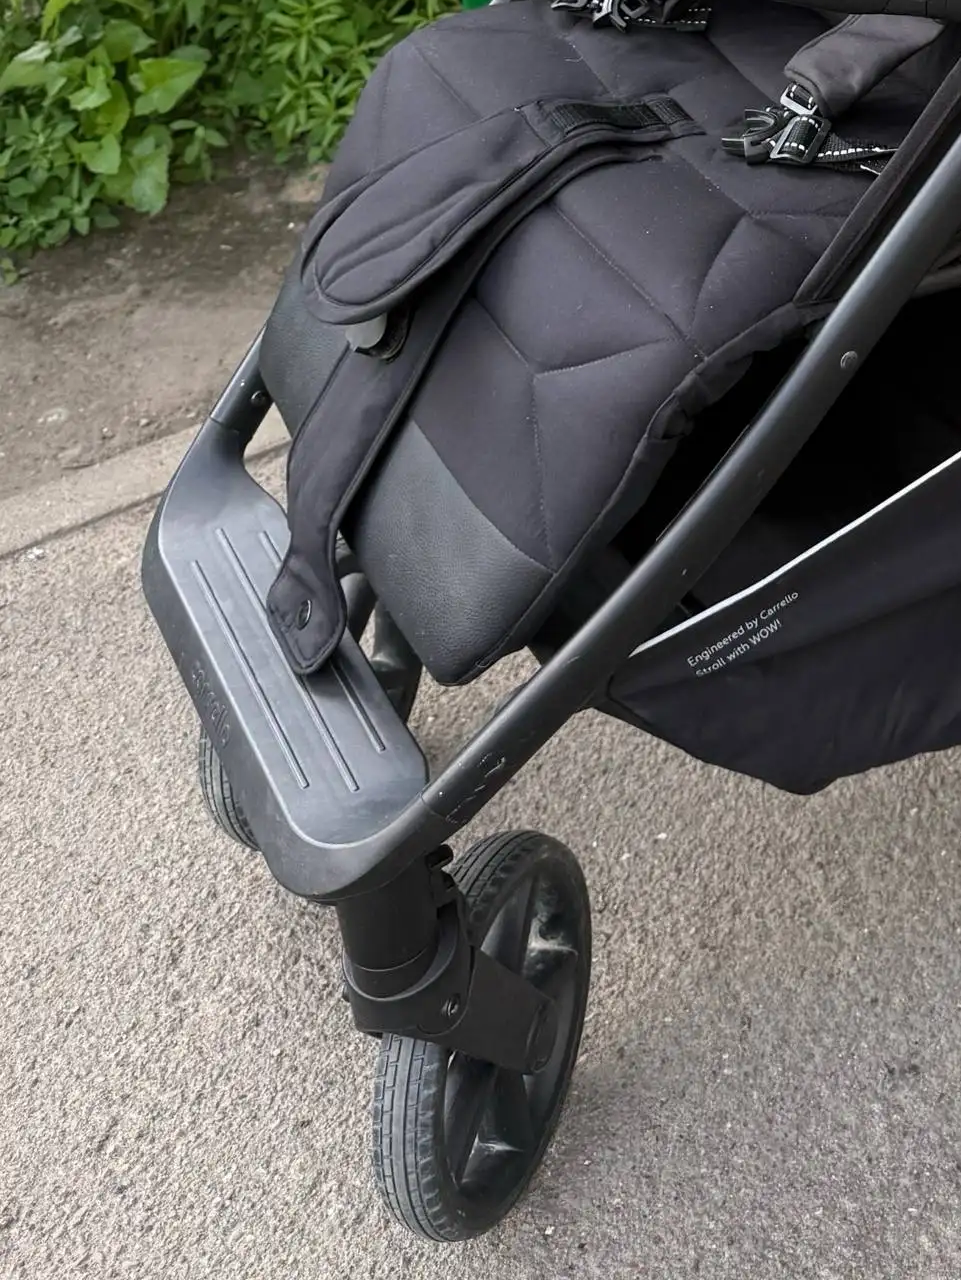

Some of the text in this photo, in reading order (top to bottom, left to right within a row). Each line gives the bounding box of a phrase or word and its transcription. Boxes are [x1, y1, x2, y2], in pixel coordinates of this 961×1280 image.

[687, 592, 799, 667] Engineered by Carrello
[727, 642, 750, 662] with
[748, 618, 782, 645] WOW!
